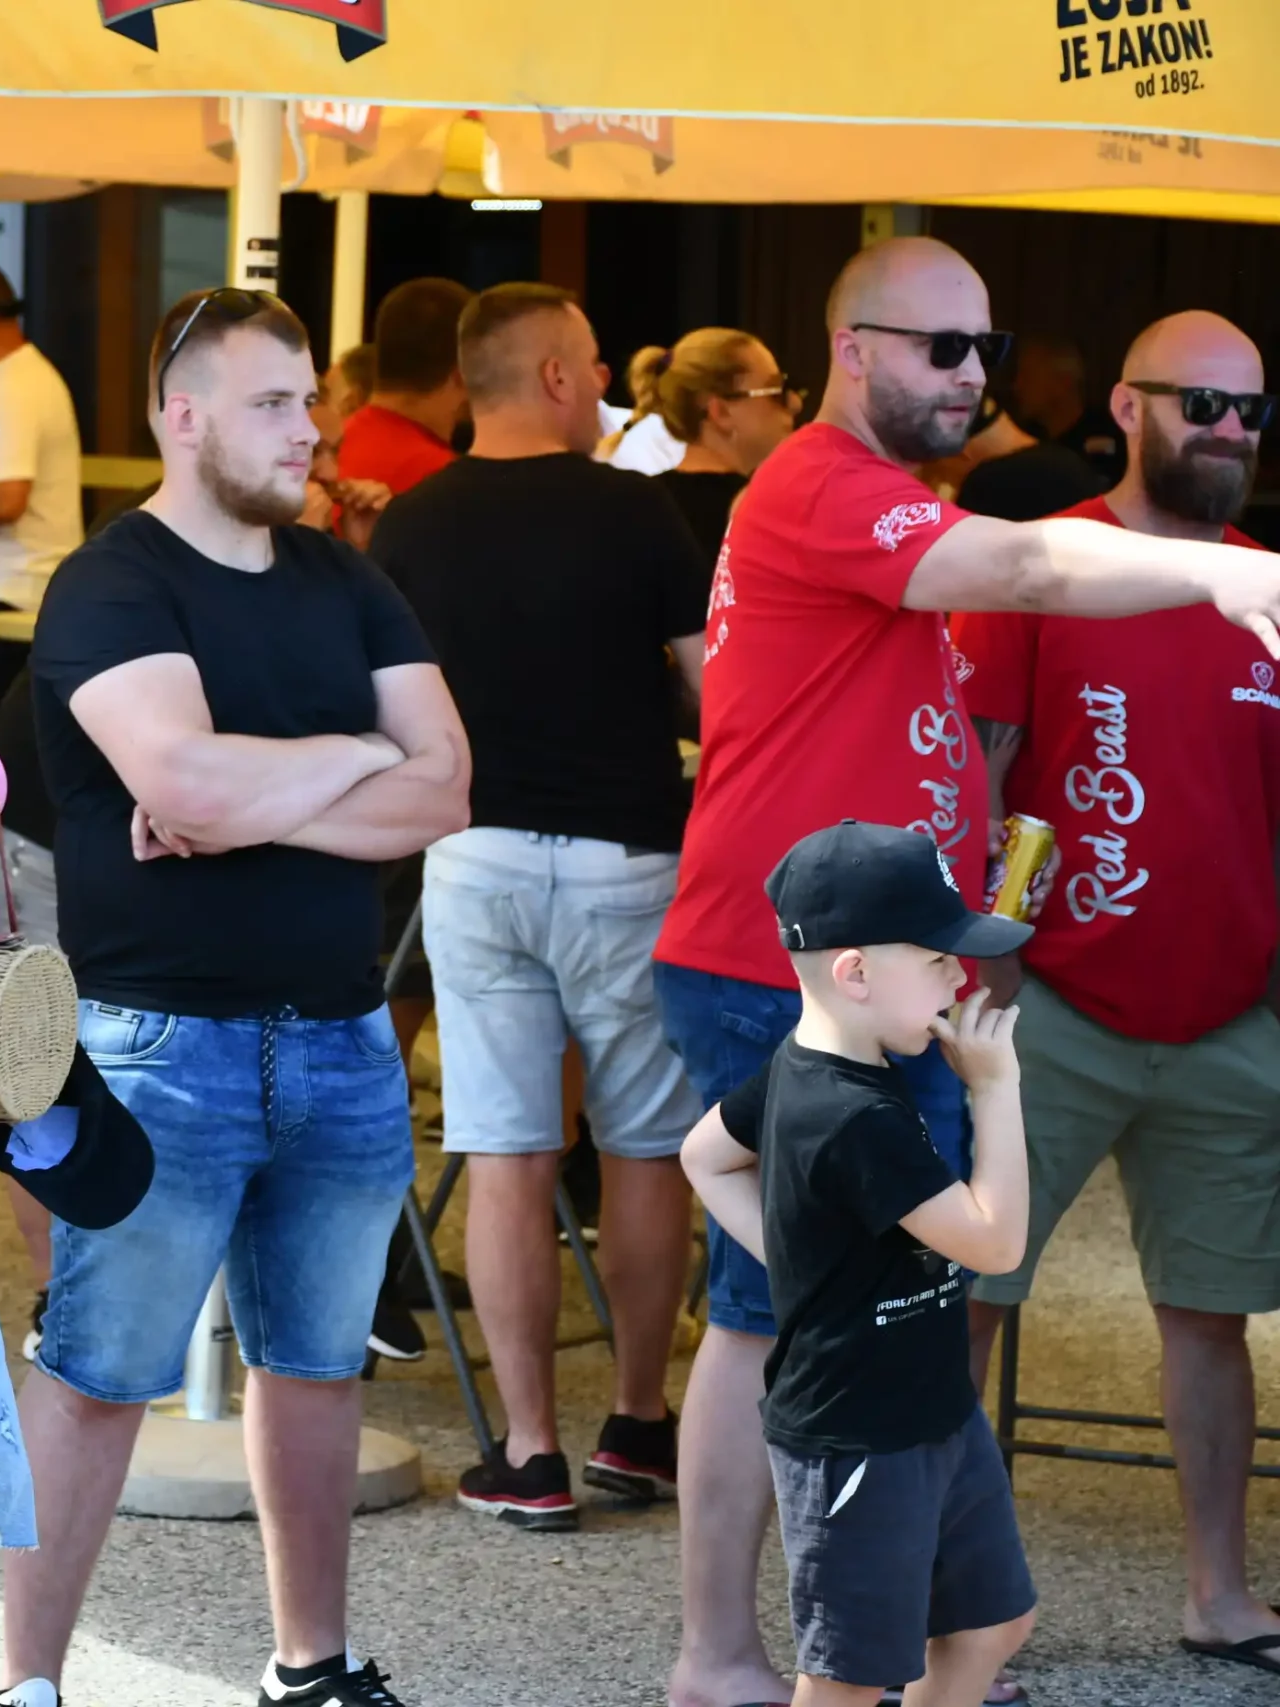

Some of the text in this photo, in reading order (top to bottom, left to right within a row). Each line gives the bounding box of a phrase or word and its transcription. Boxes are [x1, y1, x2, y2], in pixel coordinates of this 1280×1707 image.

[1059, 18, 1214, 83] JE ZAKON!
[1135, 69, 1206, 98] od 1892.
[1064, 682, 1150, 923] Red Beast
